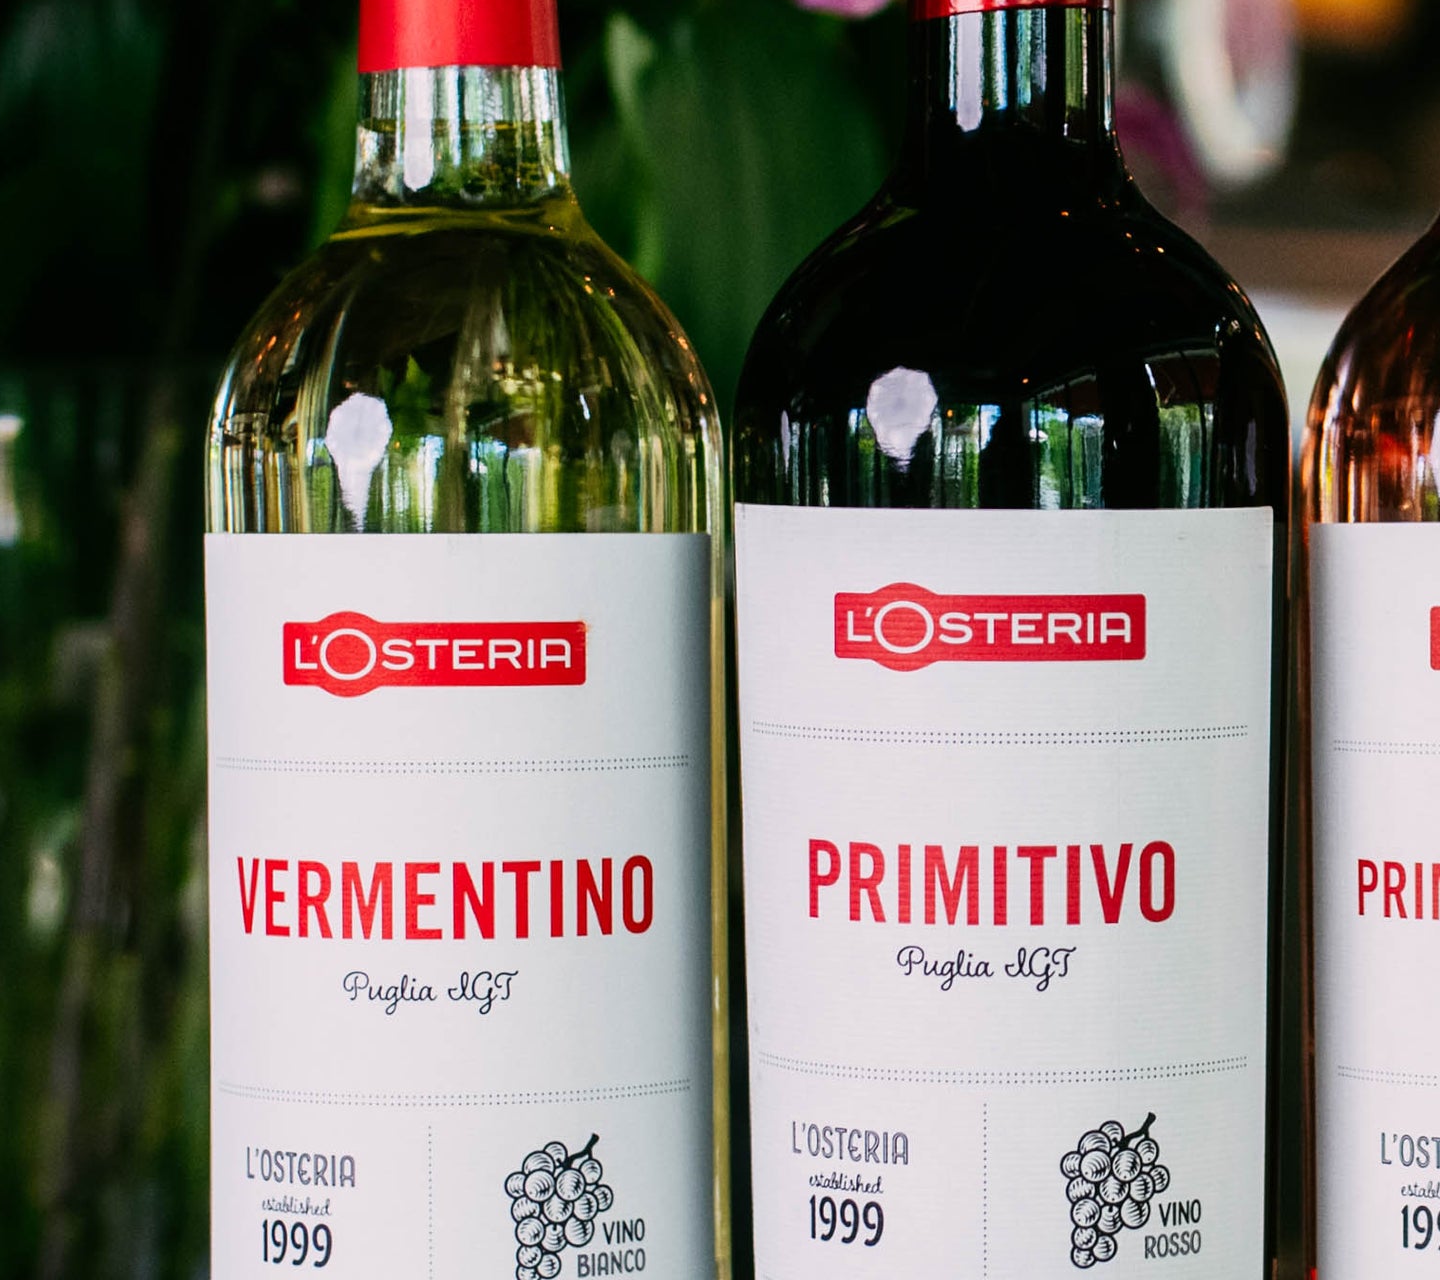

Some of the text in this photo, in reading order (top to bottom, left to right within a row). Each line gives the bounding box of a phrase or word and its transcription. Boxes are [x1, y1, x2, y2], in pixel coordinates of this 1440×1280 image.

[847, 600, 1131, 654] L'OSTERIA
[294, 627, 571, 681] L'OSTERIA
[236, 854, 654, 941] VERMENTINO
[808, 838, 1176, 927] PRIMITIVO
[896, 945, 1078, 993] Puglia IGT
[342, 970, 519, 1016] Puglia IGT
[792, 1120, 909, 1166] L'OSTERIA
[246, 1146, 356, 1188] L'OSTERIA
[808, 1171, 884, 1195] established
[261, 1196, 331, 1216] established
[809, 1194, 885, 1248] 1999
[1158, 1198, 1202, 1228] VINO
[262, 1220, 333, 1269] 1999
[601, 1217, 646, 1246] VINO
[1144, 1229, 1202, 1260] ROSSO
[577, 1247, 646, 1279] BIANCO
